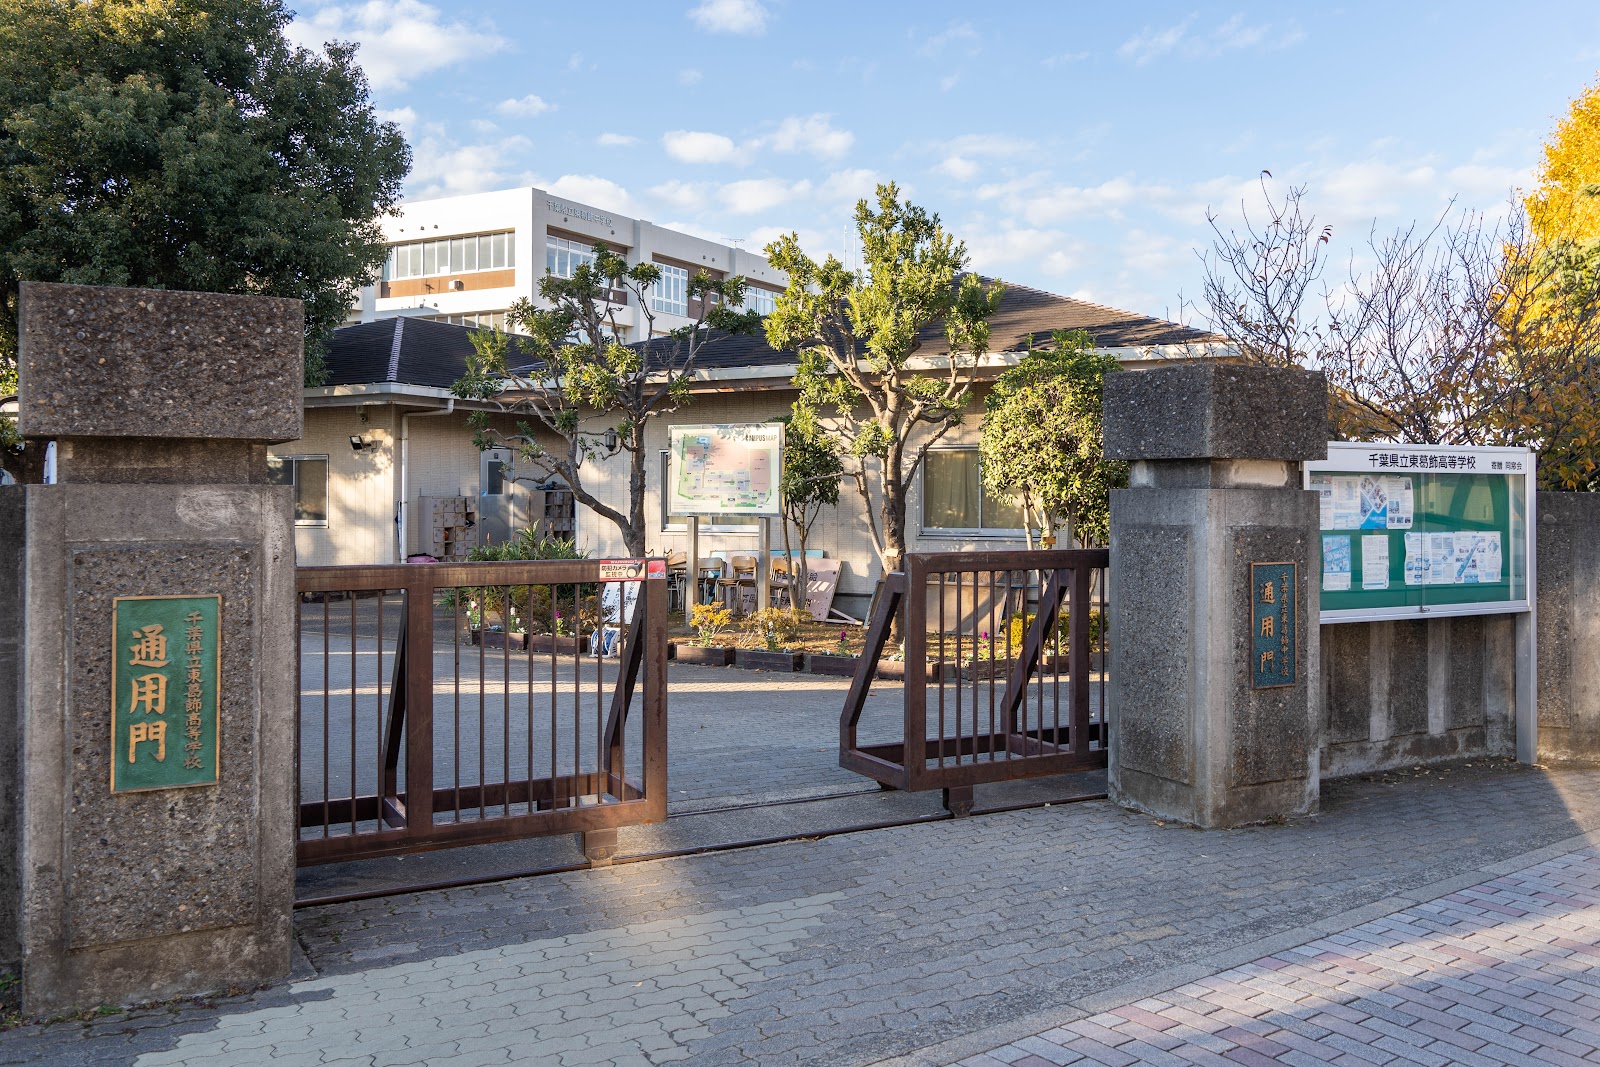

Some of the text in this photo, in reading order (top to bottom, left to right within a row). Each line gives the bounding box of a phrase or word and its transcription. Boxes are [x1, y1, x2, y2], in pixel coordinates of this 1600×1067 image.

[1369, 453, 1476, 470] 千葉県立東葛飾高等学校
[1260, 581, 1276, 674] 通用門
[129, 623, 171, 765] 通用門
[183, 610, 205, 770] 千葉県立東葛飾高等学校
